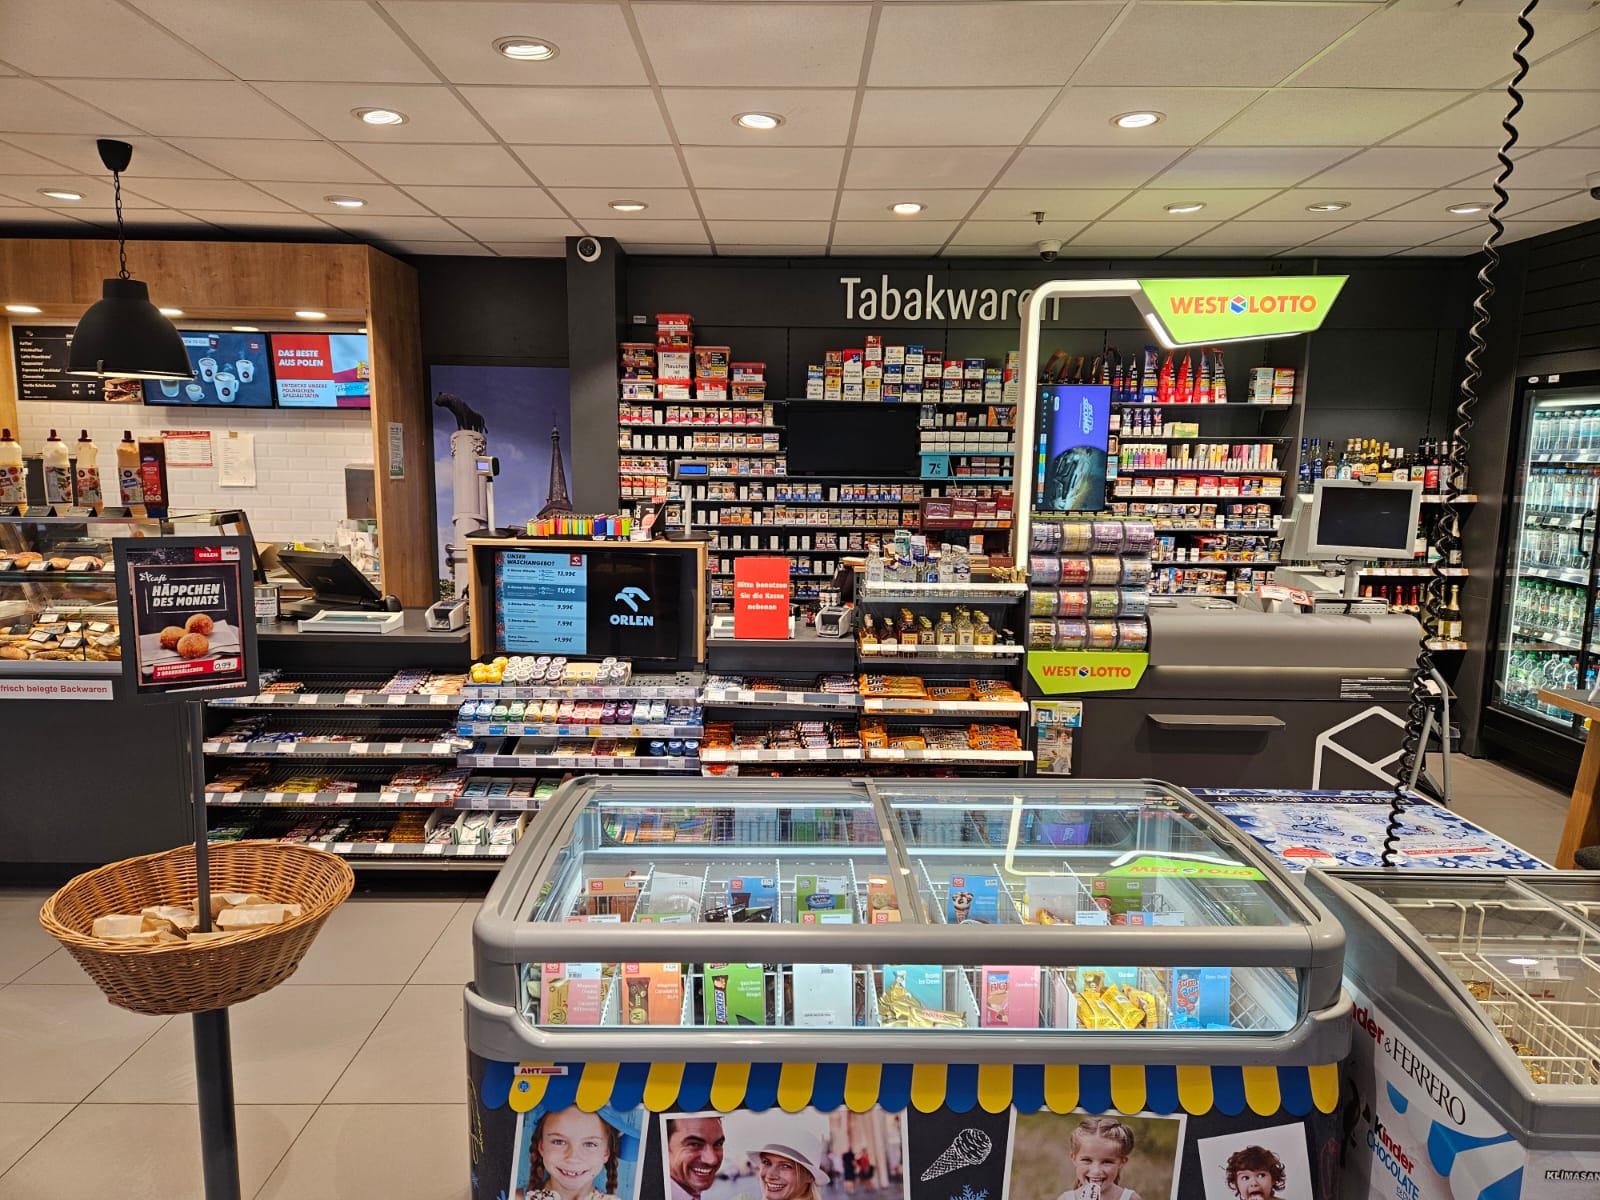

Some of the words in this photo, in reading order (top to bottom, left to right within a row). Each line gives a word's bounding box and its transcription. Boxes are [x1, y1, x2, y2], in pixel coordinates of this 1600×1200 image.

[1170, 296, 1229, 314] WEST
[1249, 295, 1316, 313] LOTTO
[279, 359, 296, 367] AUS
[152, 583, 220, 597] HÄPPCHEN
[738, 581, 754, 589] Bitte
[756, 581, 788, 589] benutzen
[152, 597, 174, 607] DES
[176, 595, 220, 606] MONATS
[610, 614, 654, 626] ORLEN
[1042, 666, 1078, 677] WEST
[1090, 667, 1132, 678] LOTTO
[0, 684, 24, 692] frisch
[27, 685, 58, 694] belegte
[60, 685, 108, 693] Backwaren
[714, 990, 727, 1023] SNICKERS
[1384, 1037, 1392, 1054] &
[1393, 1037, 1466, 1126] FERRERO
[1374, 1113, 1415, 1175] kinder
[1366, 1129, 1421, 1200] CHOCOLATE
